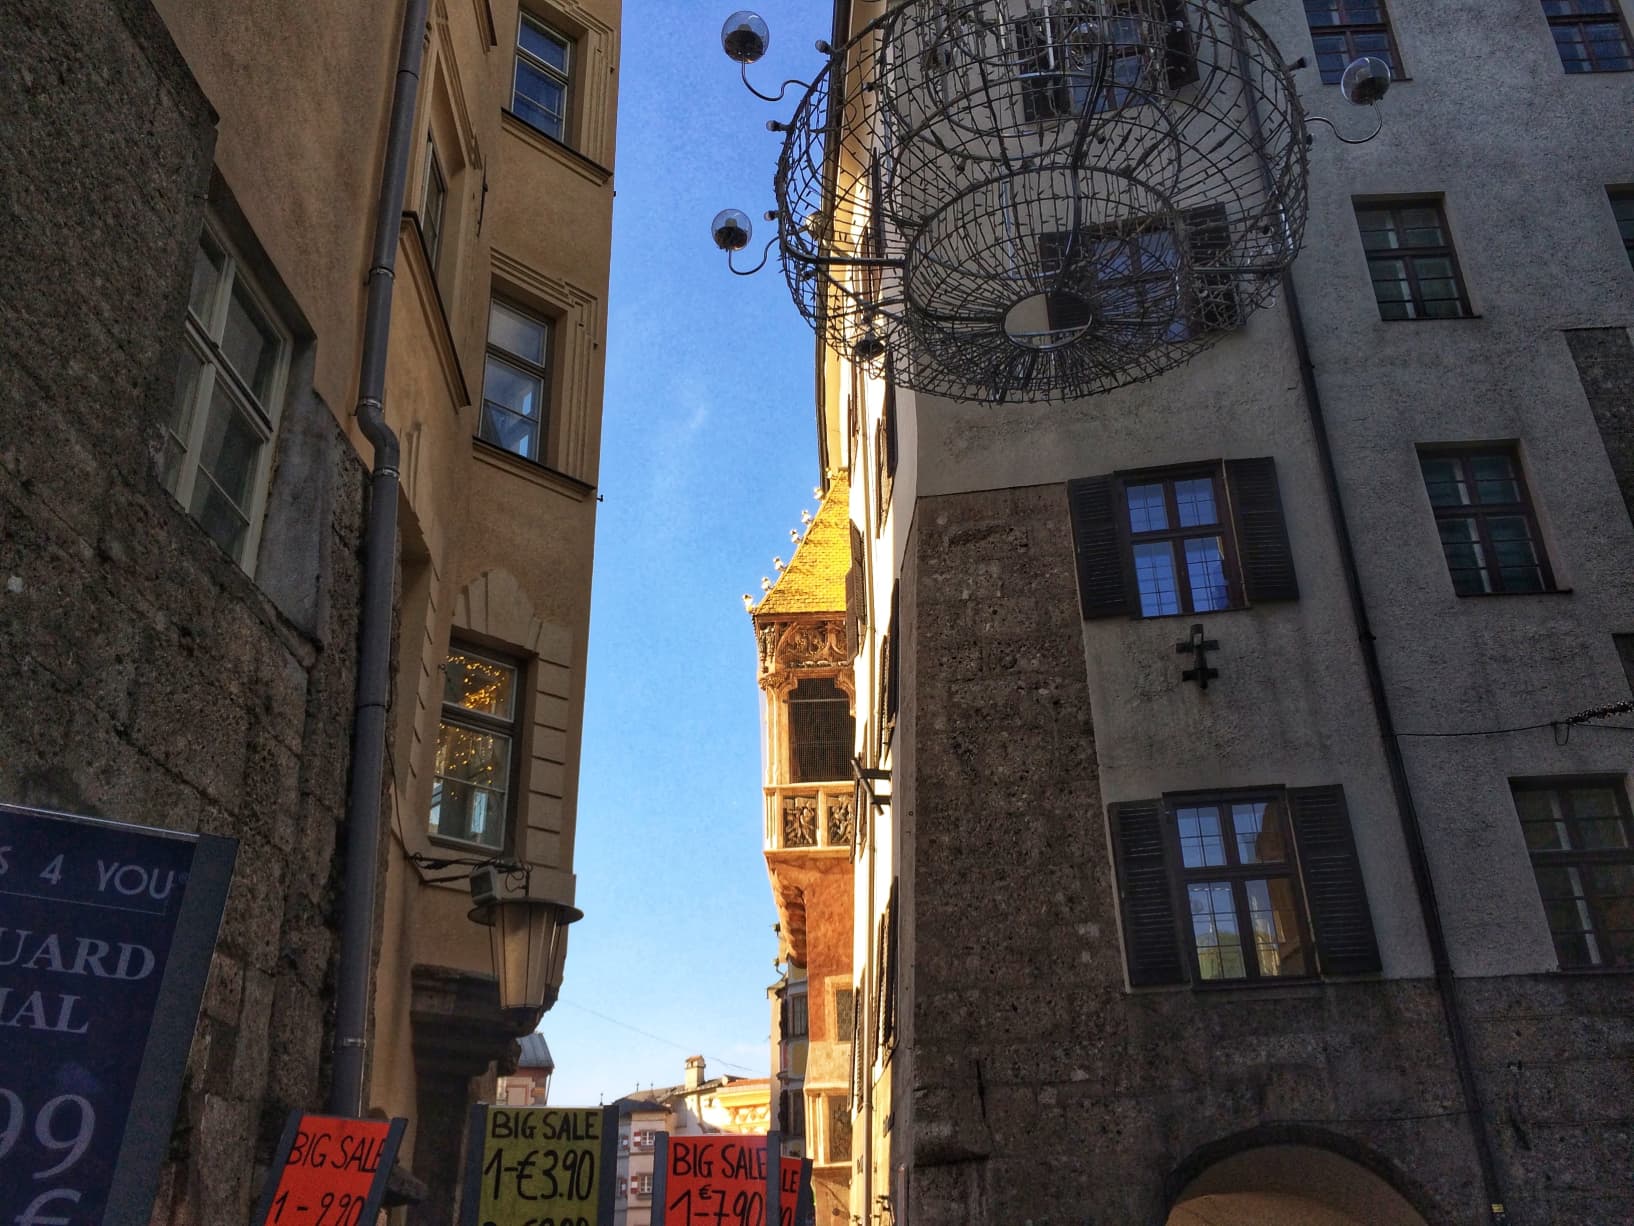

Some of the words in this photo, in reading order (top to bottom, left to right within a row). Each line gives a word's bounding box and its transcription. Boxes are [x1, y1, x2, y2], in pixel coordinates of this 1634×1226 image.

[40, 854, 63, 885] 4
[492, 1111, 537, 1139] BIG
[542, 1111, 599, 1141] SALE
[286, 1132, 331, 1168] BIG
[673, 1142, 713, 1178] BIG
[720, 1144, 767, 1180] SALE
